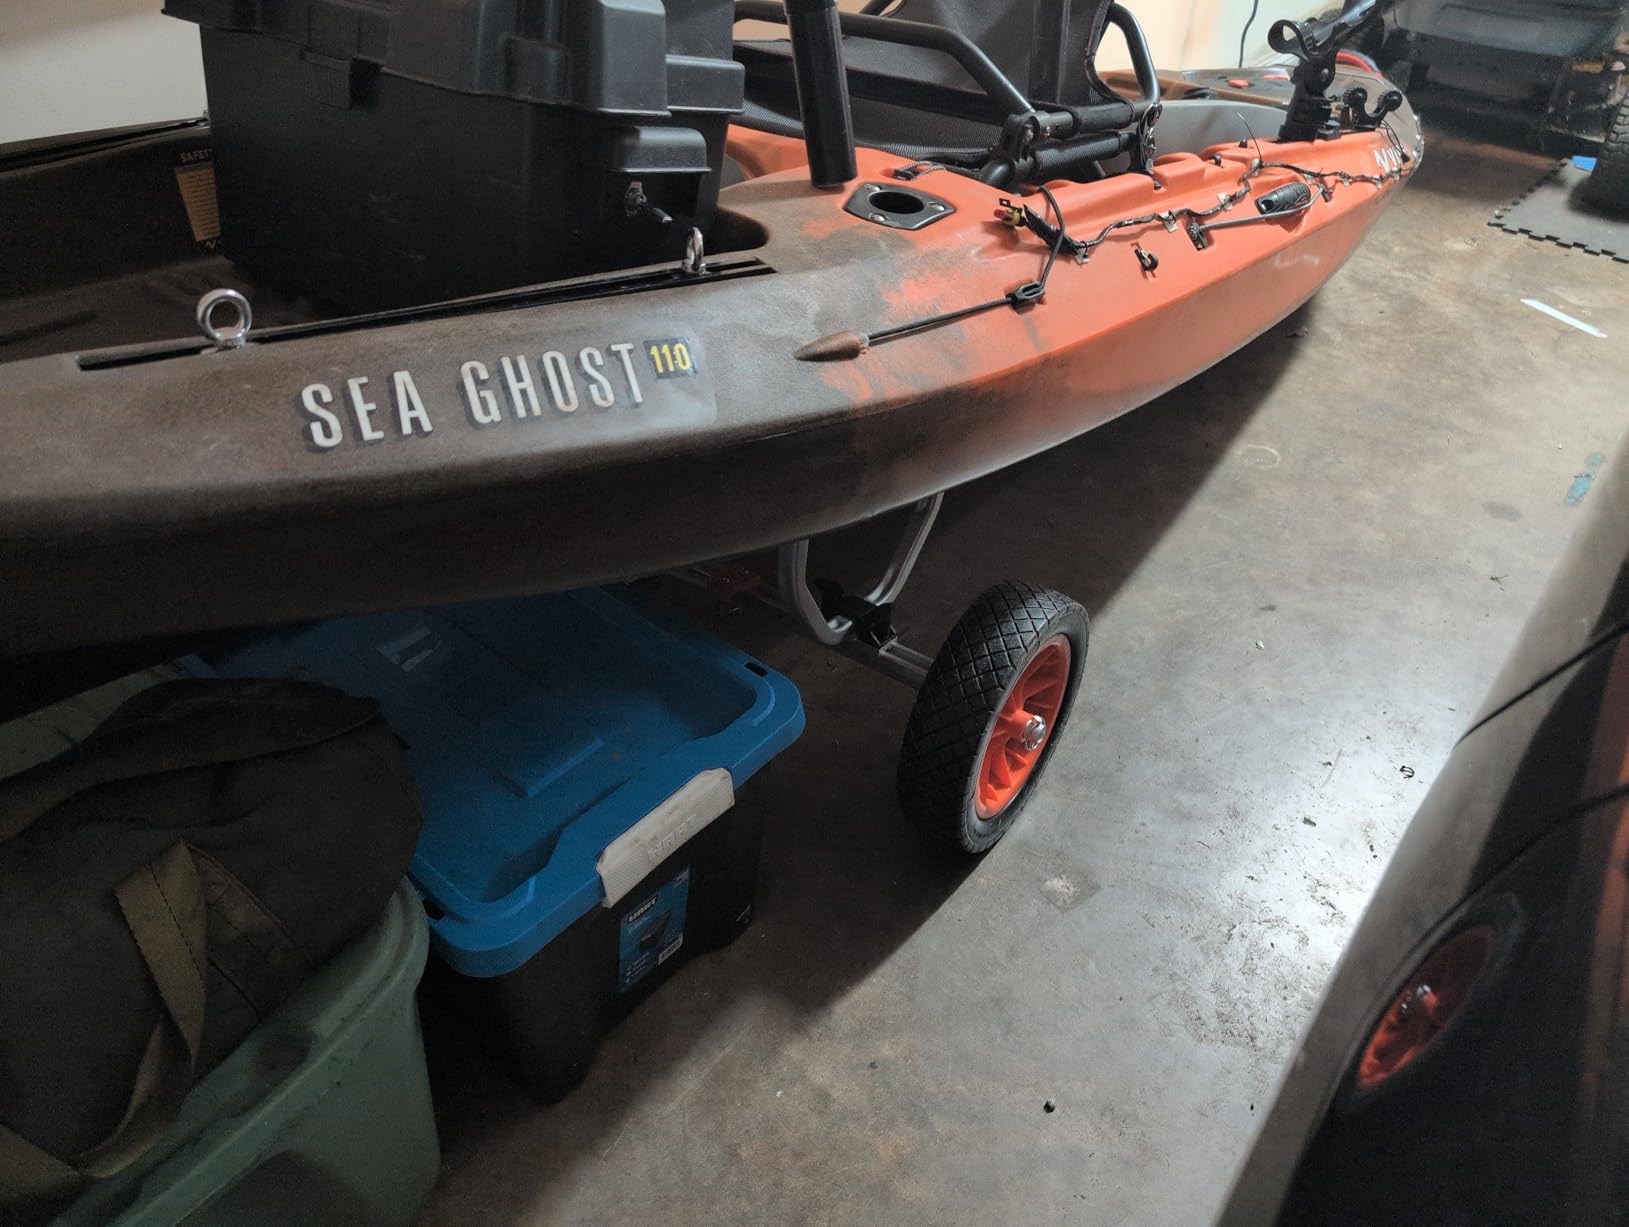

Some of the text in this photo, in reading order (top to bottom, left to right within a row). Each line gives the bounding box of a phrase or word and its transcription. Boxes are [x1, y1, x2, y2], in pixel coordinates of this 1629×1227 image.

[301, 342, 693, 449] SEA GHOST 110
